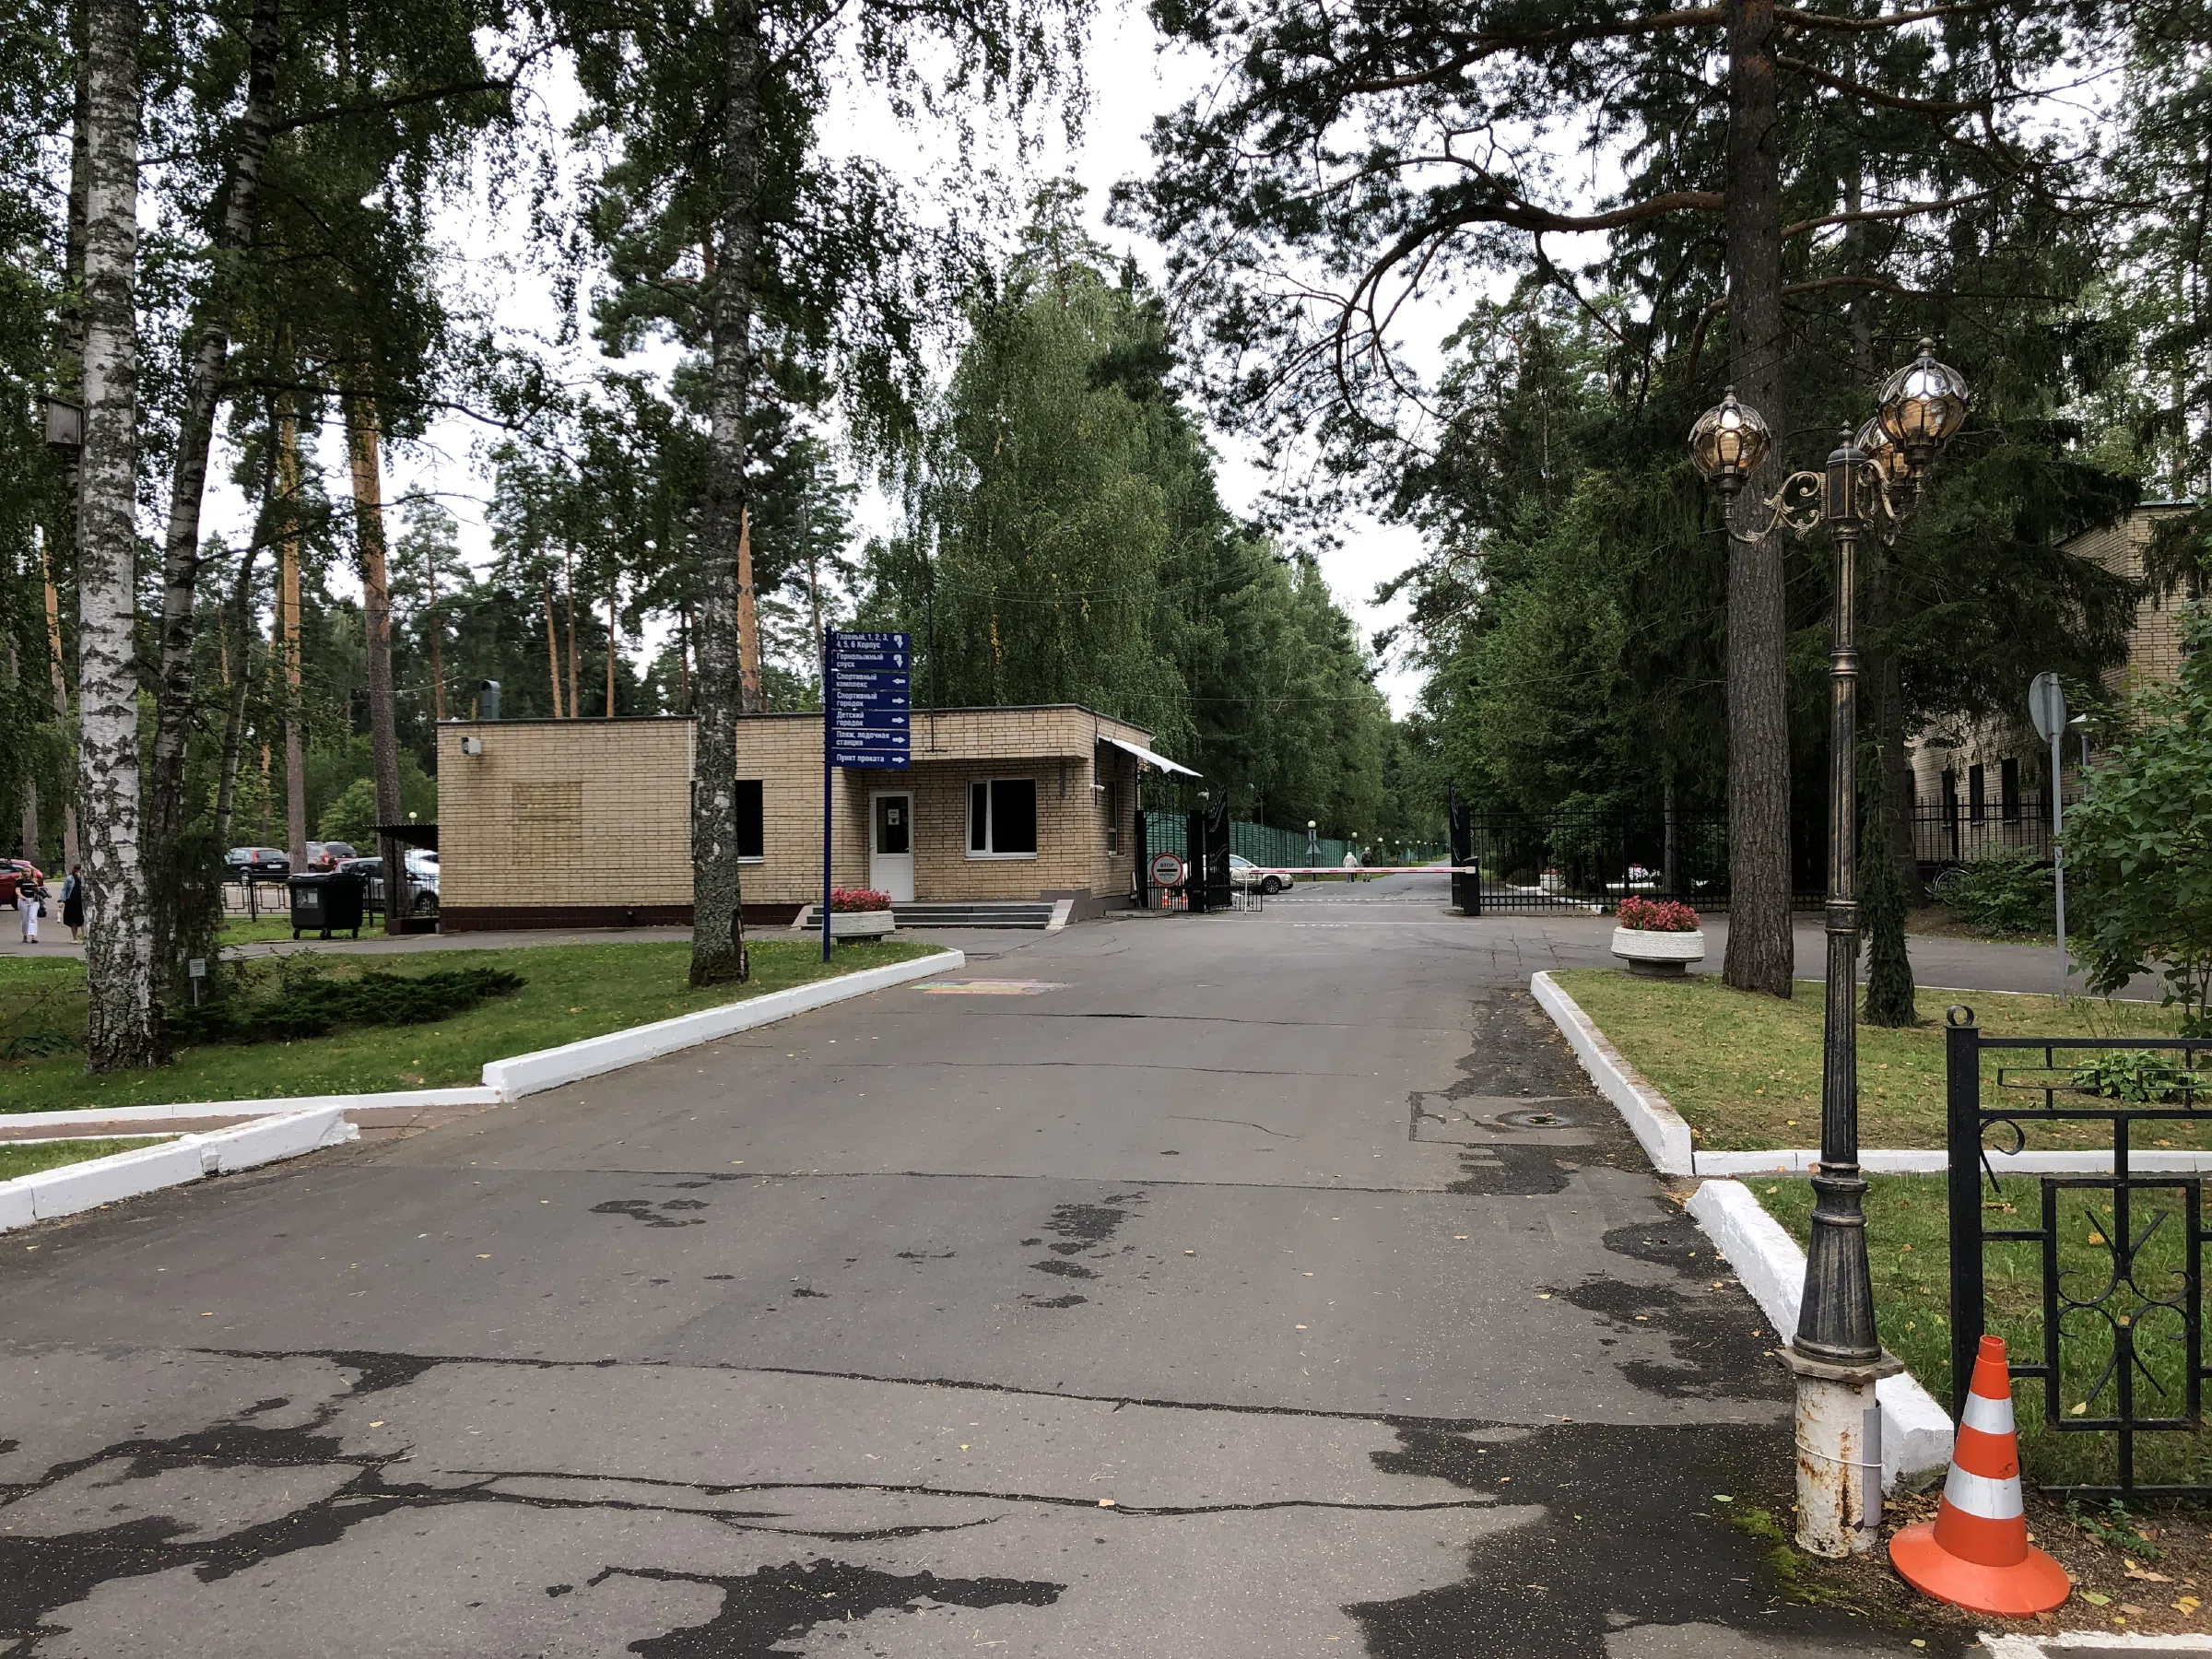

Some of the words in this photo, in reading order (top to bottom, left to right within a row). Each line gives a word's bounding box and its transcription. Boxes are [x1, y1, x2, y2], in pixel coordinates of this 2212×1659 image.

[836, 633, 867, 641] Главный,
[857, 641, 881, 649] Корпус
[836, 653, 884, 661] Горнолыжный
[836, 672, 877, 681] Спортивный
[836, 692, 877, 700] Спортивный
[836, 753, 856, 762] Пункт
